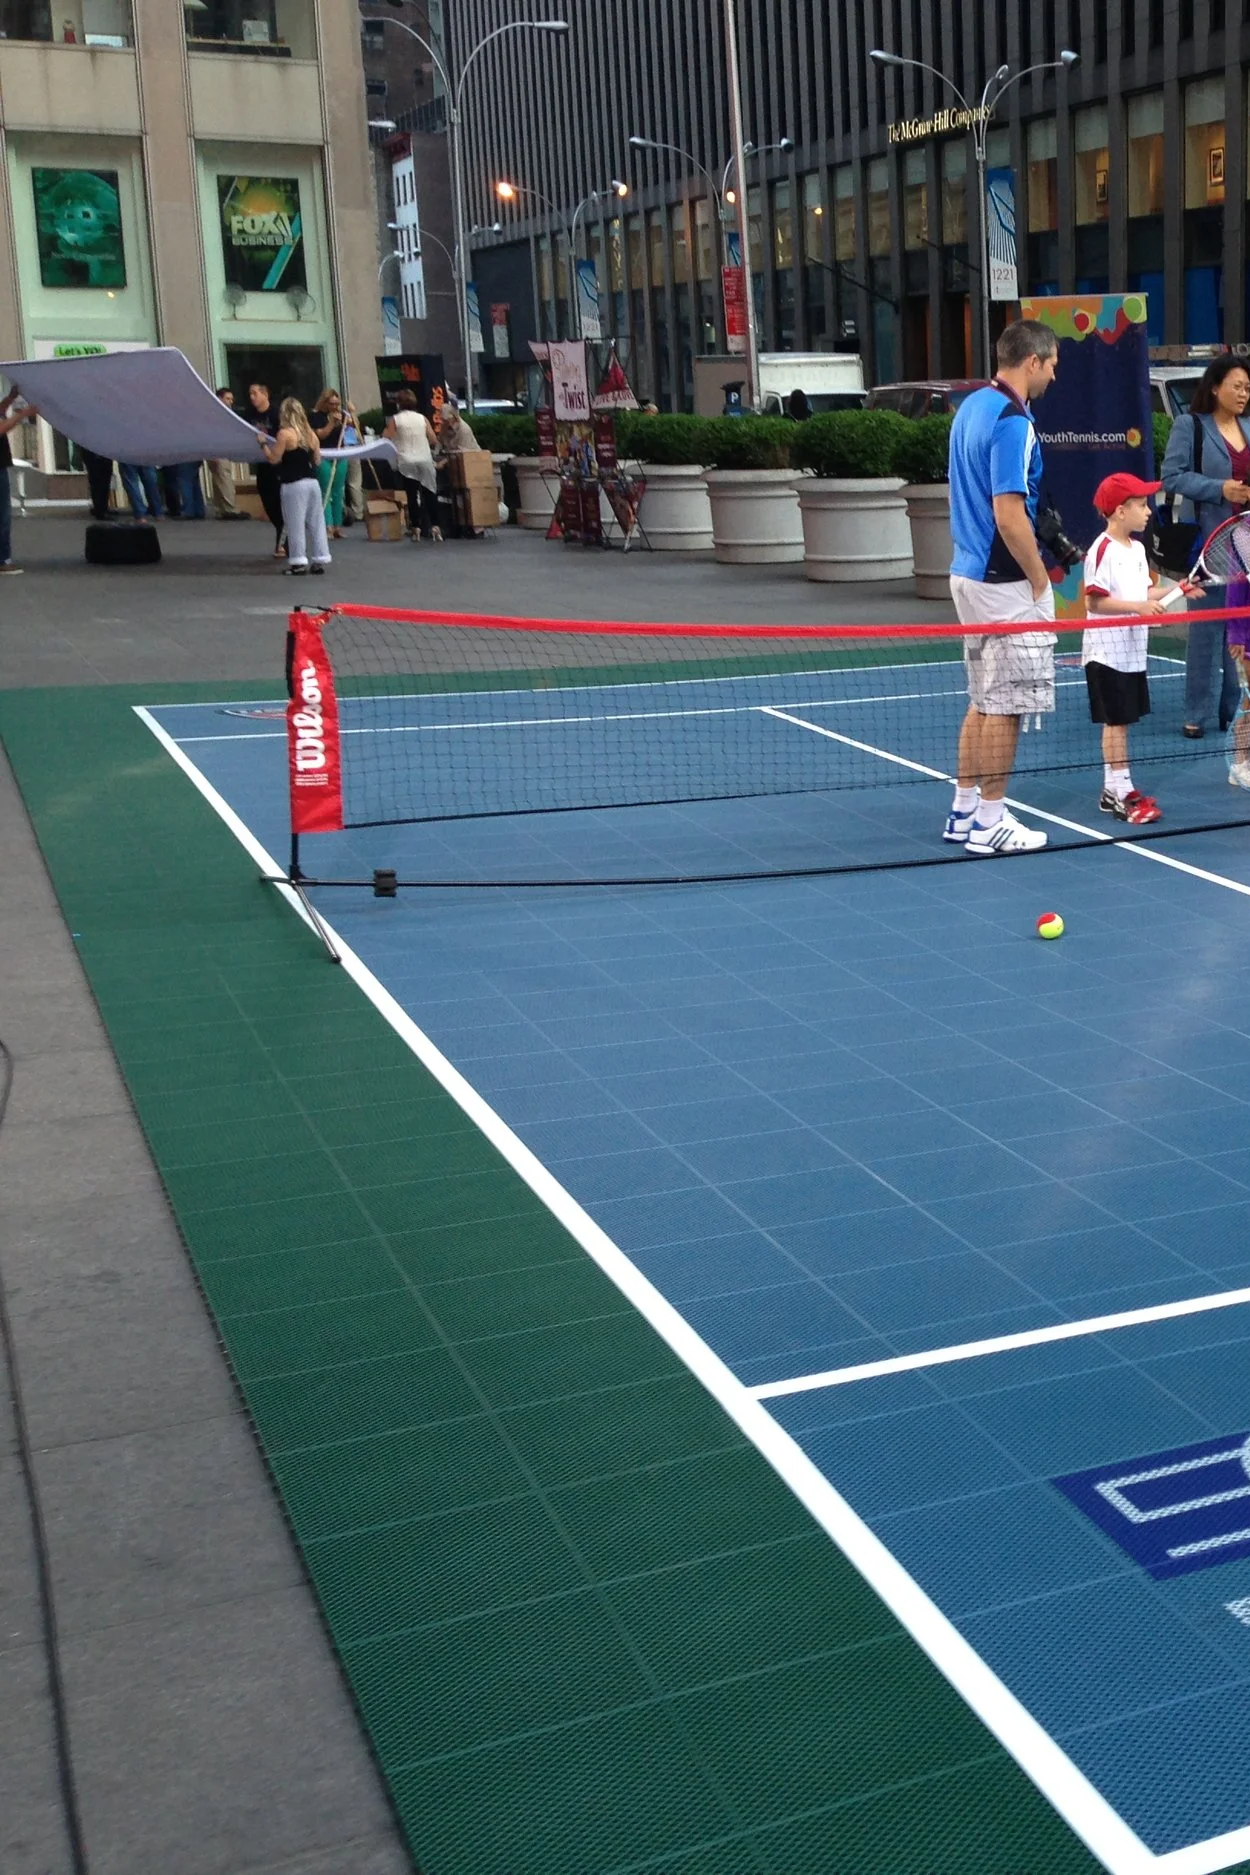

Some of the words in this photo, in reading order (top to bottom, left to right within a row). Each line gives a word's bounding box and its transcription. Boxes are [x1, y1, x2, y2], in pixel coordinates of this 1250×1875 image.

[231, 211, 281, 235] FOX
[991, 267, 1014, 281] 1221
[730, 391, 739, 403] P
[293, 660, 326, 772] Wilson
